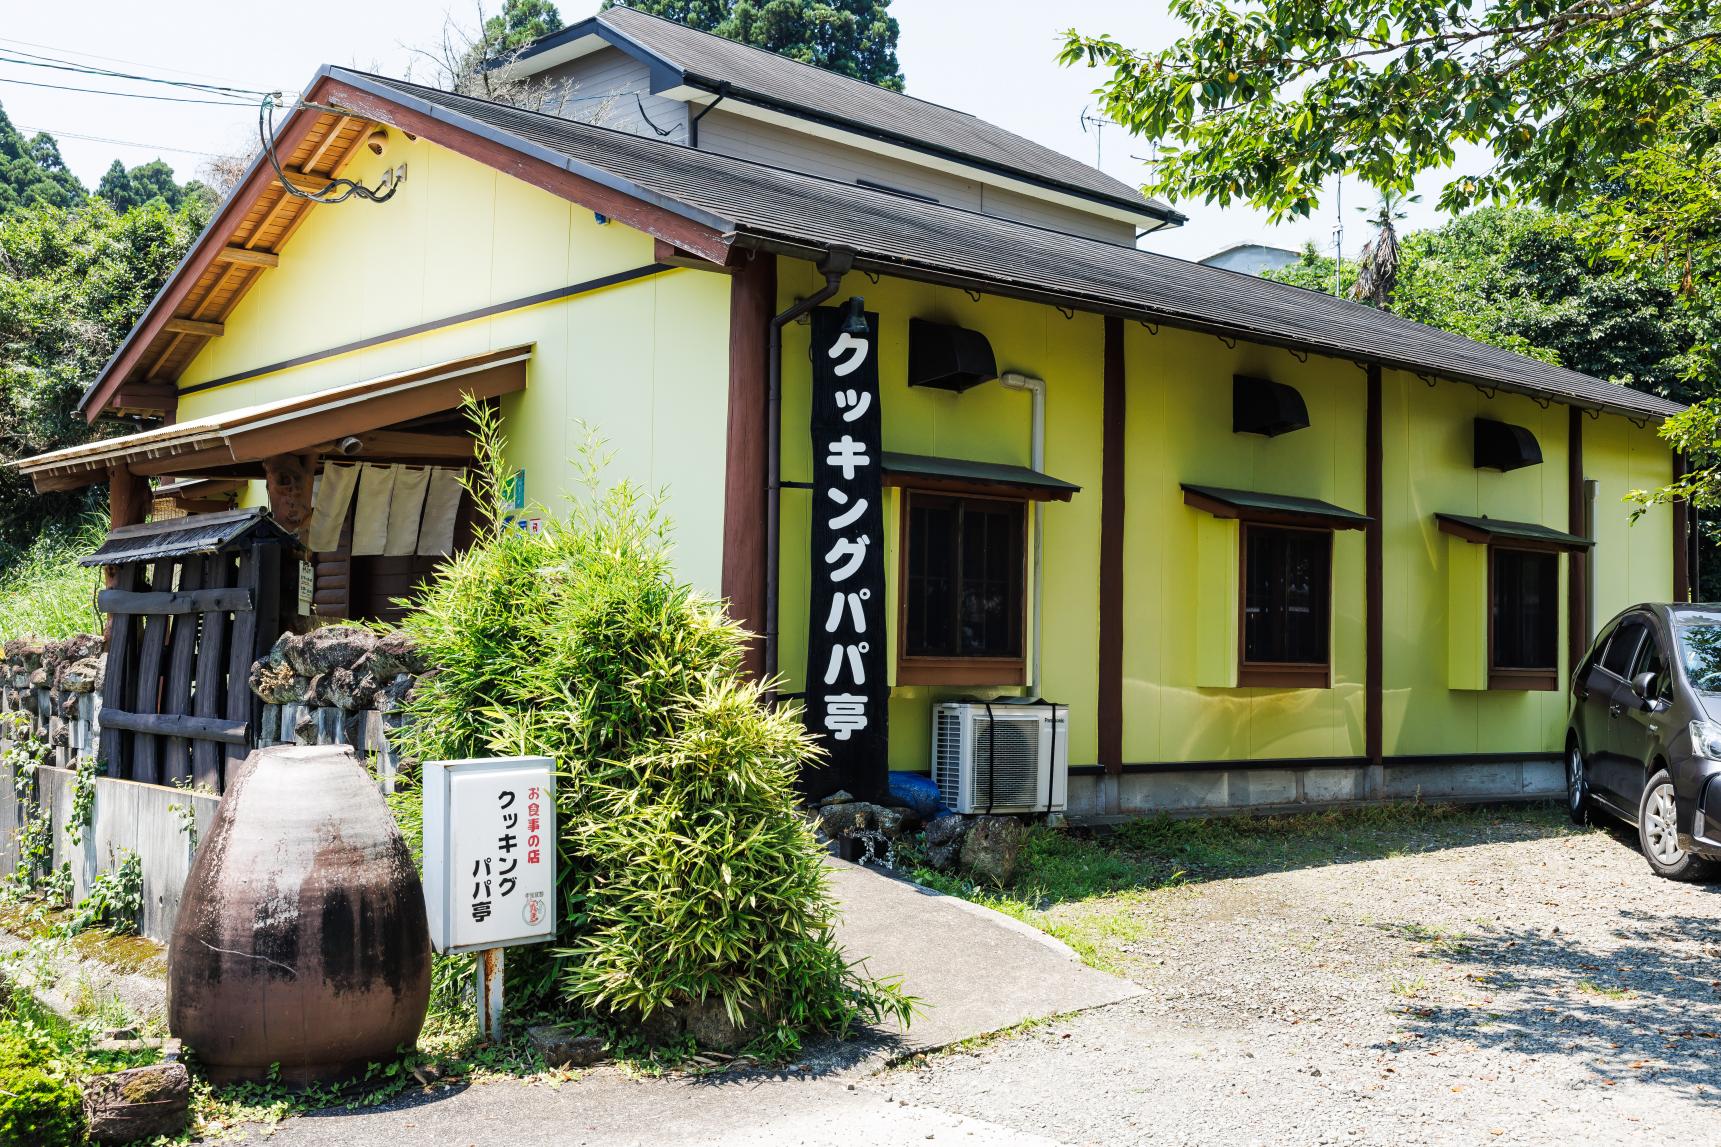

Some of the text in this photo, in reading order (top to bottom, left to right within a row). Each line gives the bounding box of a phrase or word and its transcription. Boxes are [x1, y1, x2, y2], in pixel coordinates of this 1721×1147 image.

[824, 333, 871, 741] クッキングパパ亭
[498, 790, 518, 897] クッキング
[527, 787, 540, 864] お食事の店
[472, 857, 492, 923] パパ亭
